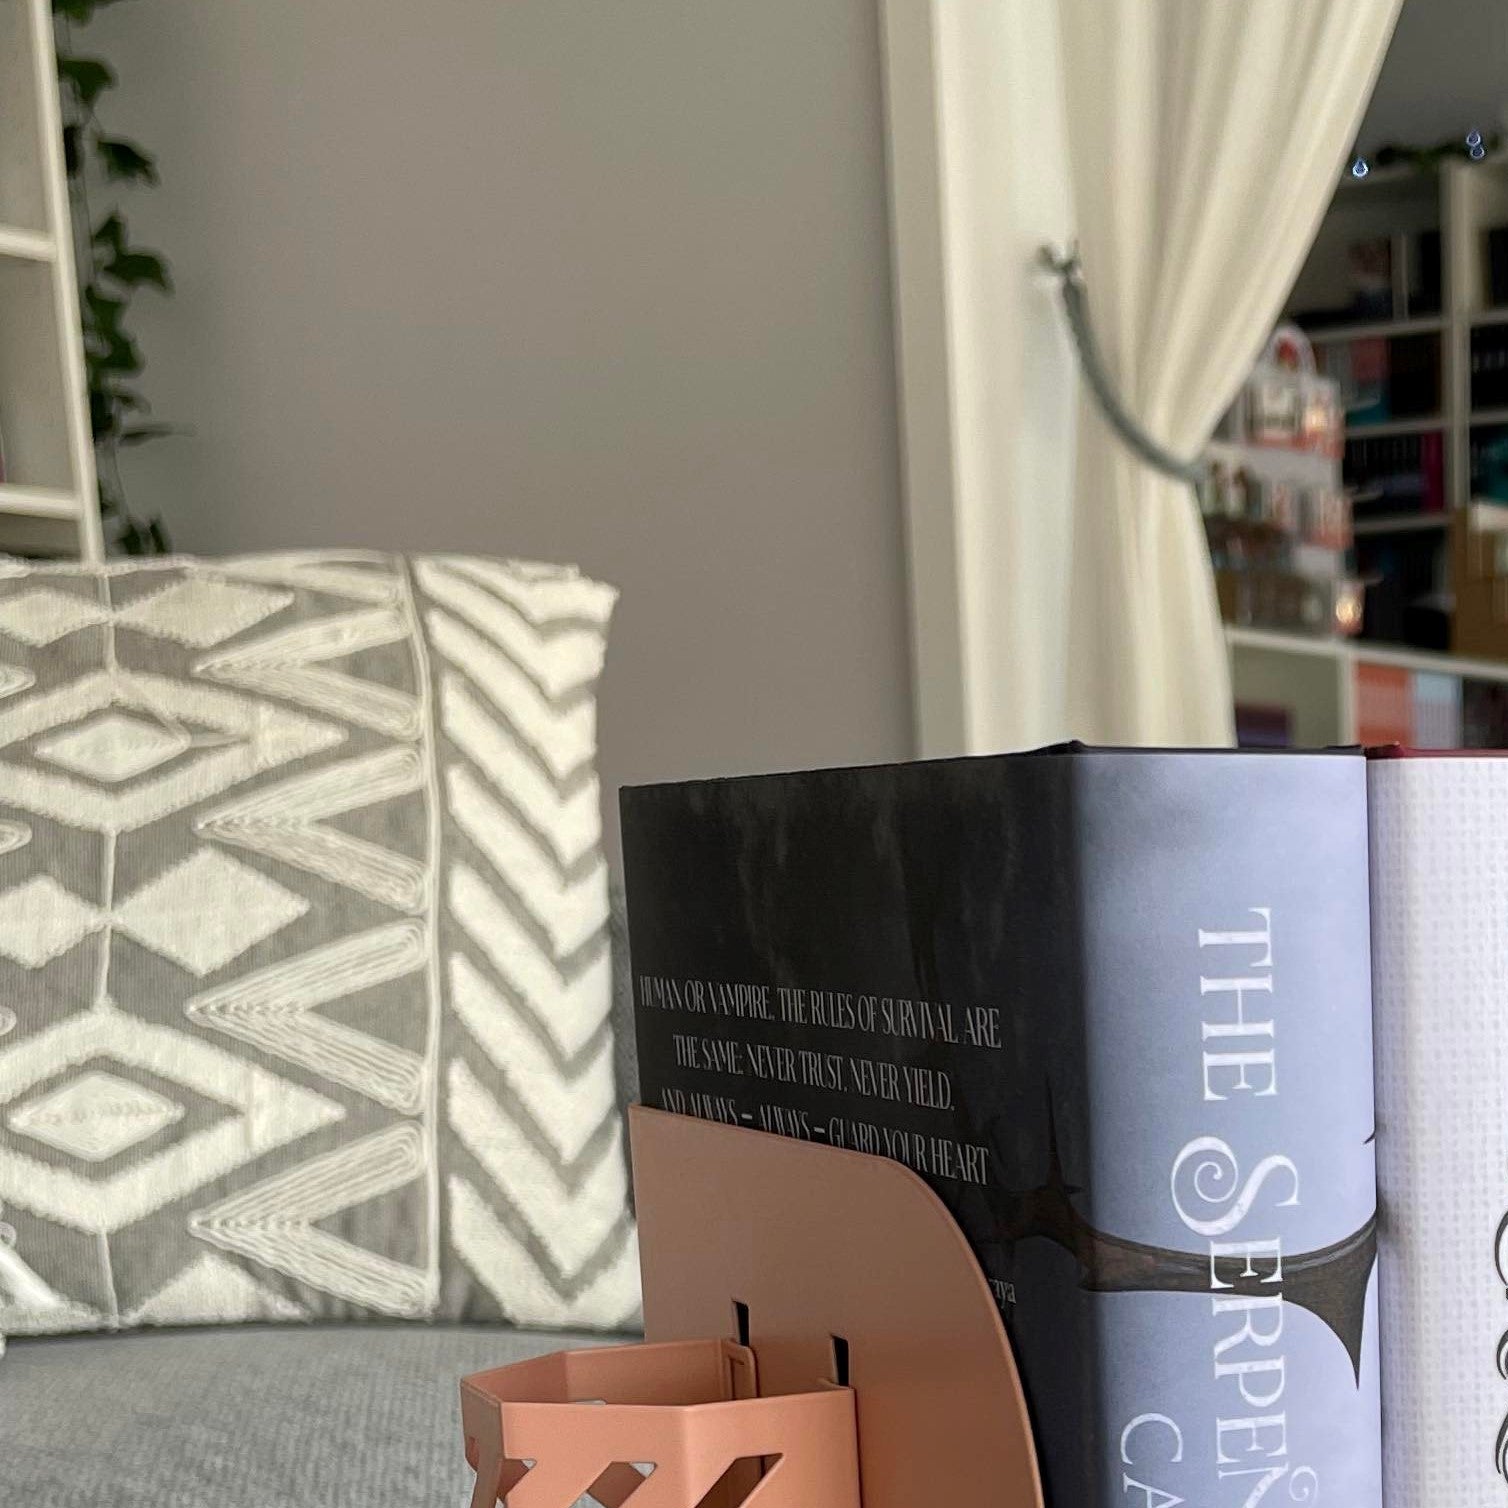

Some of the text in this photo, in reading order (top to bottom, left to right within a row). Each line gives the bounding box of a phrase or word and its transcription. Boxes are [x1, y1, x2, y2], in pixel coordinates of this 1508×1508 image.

[684, 979, 707, 1014] OR
[776, 986, 808, 1024] THE
[809, 989, 856, 1030] RULES
[857, 994, 878, 1033] OF
[881, 997, 959, 1044] SURVIVAL
[964, 1005, 1001, 1049] ARE
[1198, 906, 1278, 1101] THE
[673, 1033, 700, 1069] THE
[746, 1042, 798, 1083] NEVER
[849, 1057, 901, 1102] NEVER
[883, 1126, 929, 1173] YOUR
[930, 1135, 990, 1187] HEART
